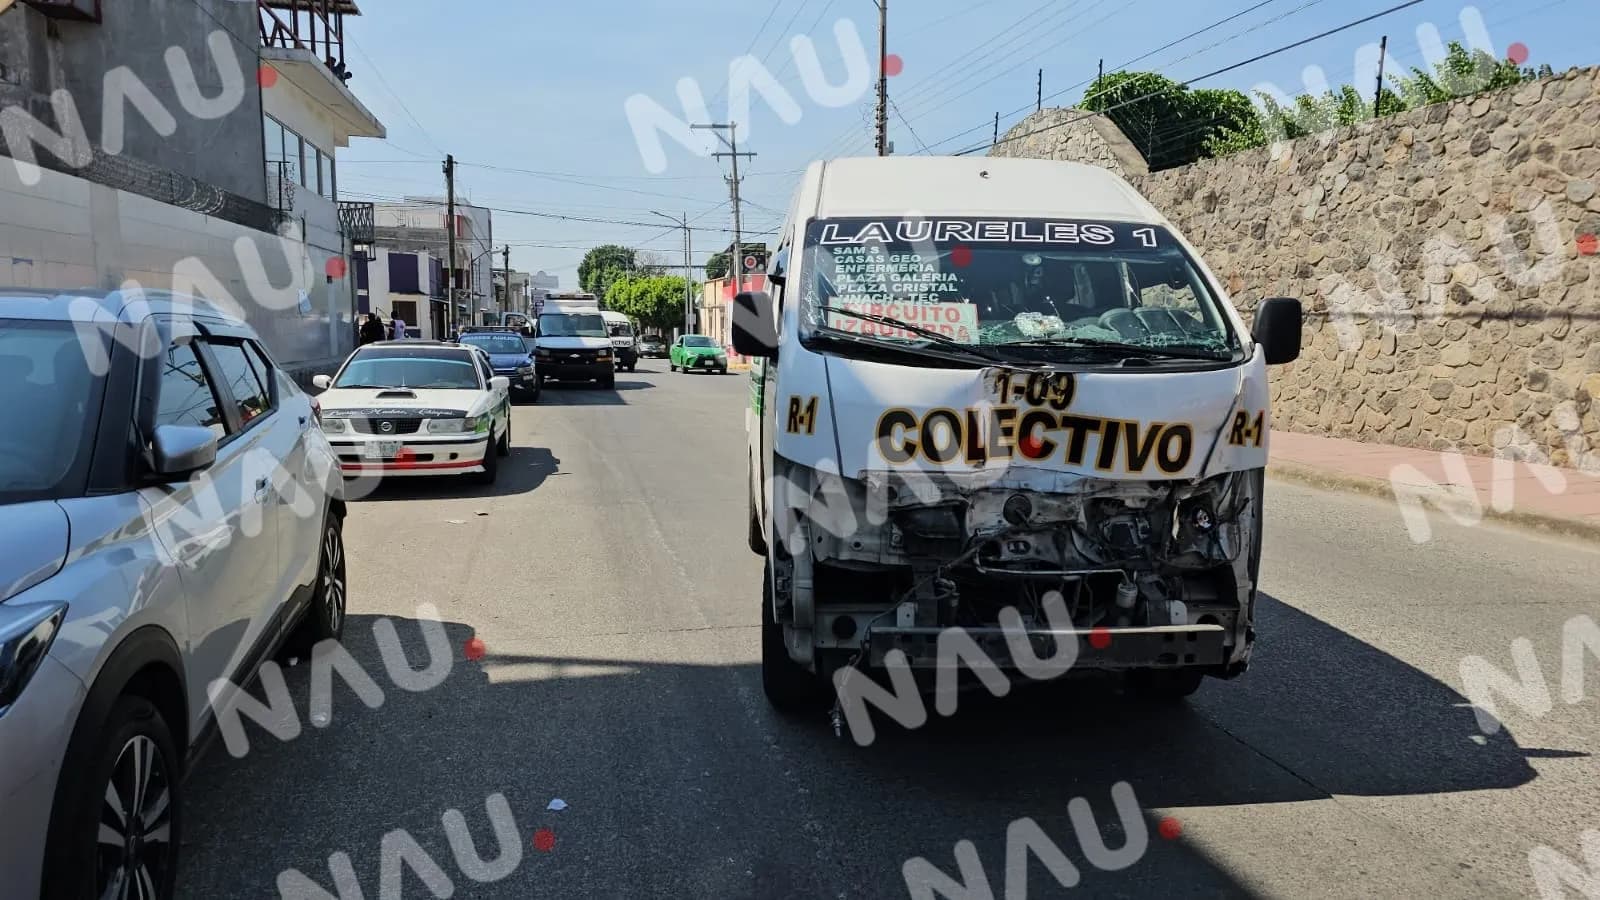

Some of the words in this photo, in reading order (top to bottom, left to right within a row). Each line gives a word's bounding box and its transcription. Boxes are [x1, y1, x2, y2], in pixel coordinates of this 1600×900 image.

[820, 219, 1115, 246] LAURELES
[1132, 226, 1158, 248] 1
[833, 246, 865, 255] SAM
[834, 255, 885, 264] CASAS
[891, 254, 921, 263] GEO
[835, 263, 935, 273] ENFERMERIA
[836, 274, 887, 283] PLAZA
[838, 283, 888, 293] PLAZA
[892, 283, 958, 292] CRISTAL
[908, 293, 940, 303] TEC
[787, 396, 818, 435] R-1
[1230, 409, 1265, 448] R-1
[876, 408, 1193, 474] COLECTIVO
